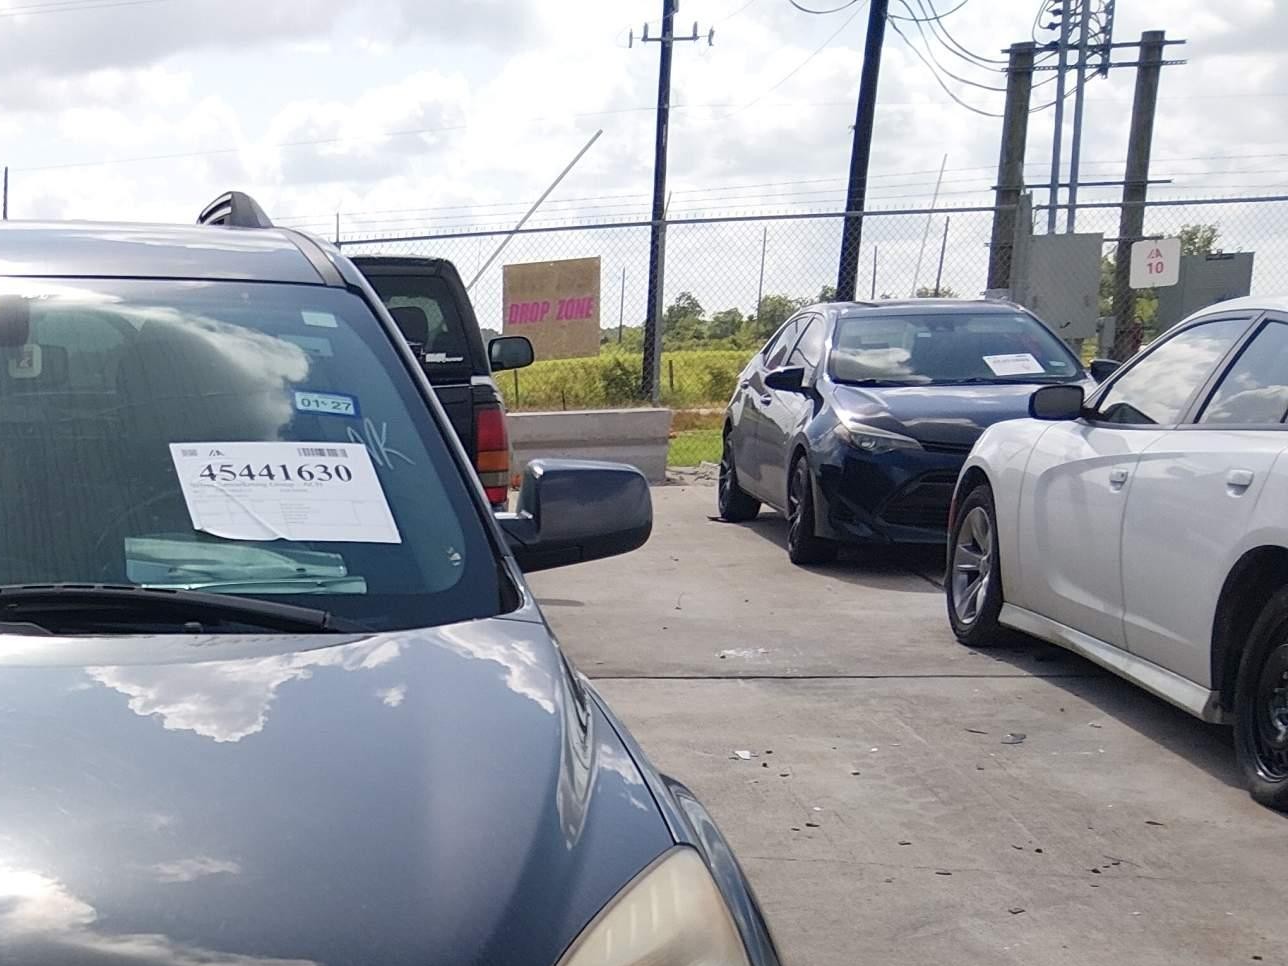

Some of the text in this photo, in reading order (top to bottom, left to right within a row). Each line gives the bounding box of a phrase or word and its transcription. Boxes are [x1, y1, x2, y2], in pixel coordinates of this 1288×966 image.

[1147, 261, 1164, 274] 10
[508, 297, 594, 324] DROP ZONE
[198, 463, 353, 483] 45441630
